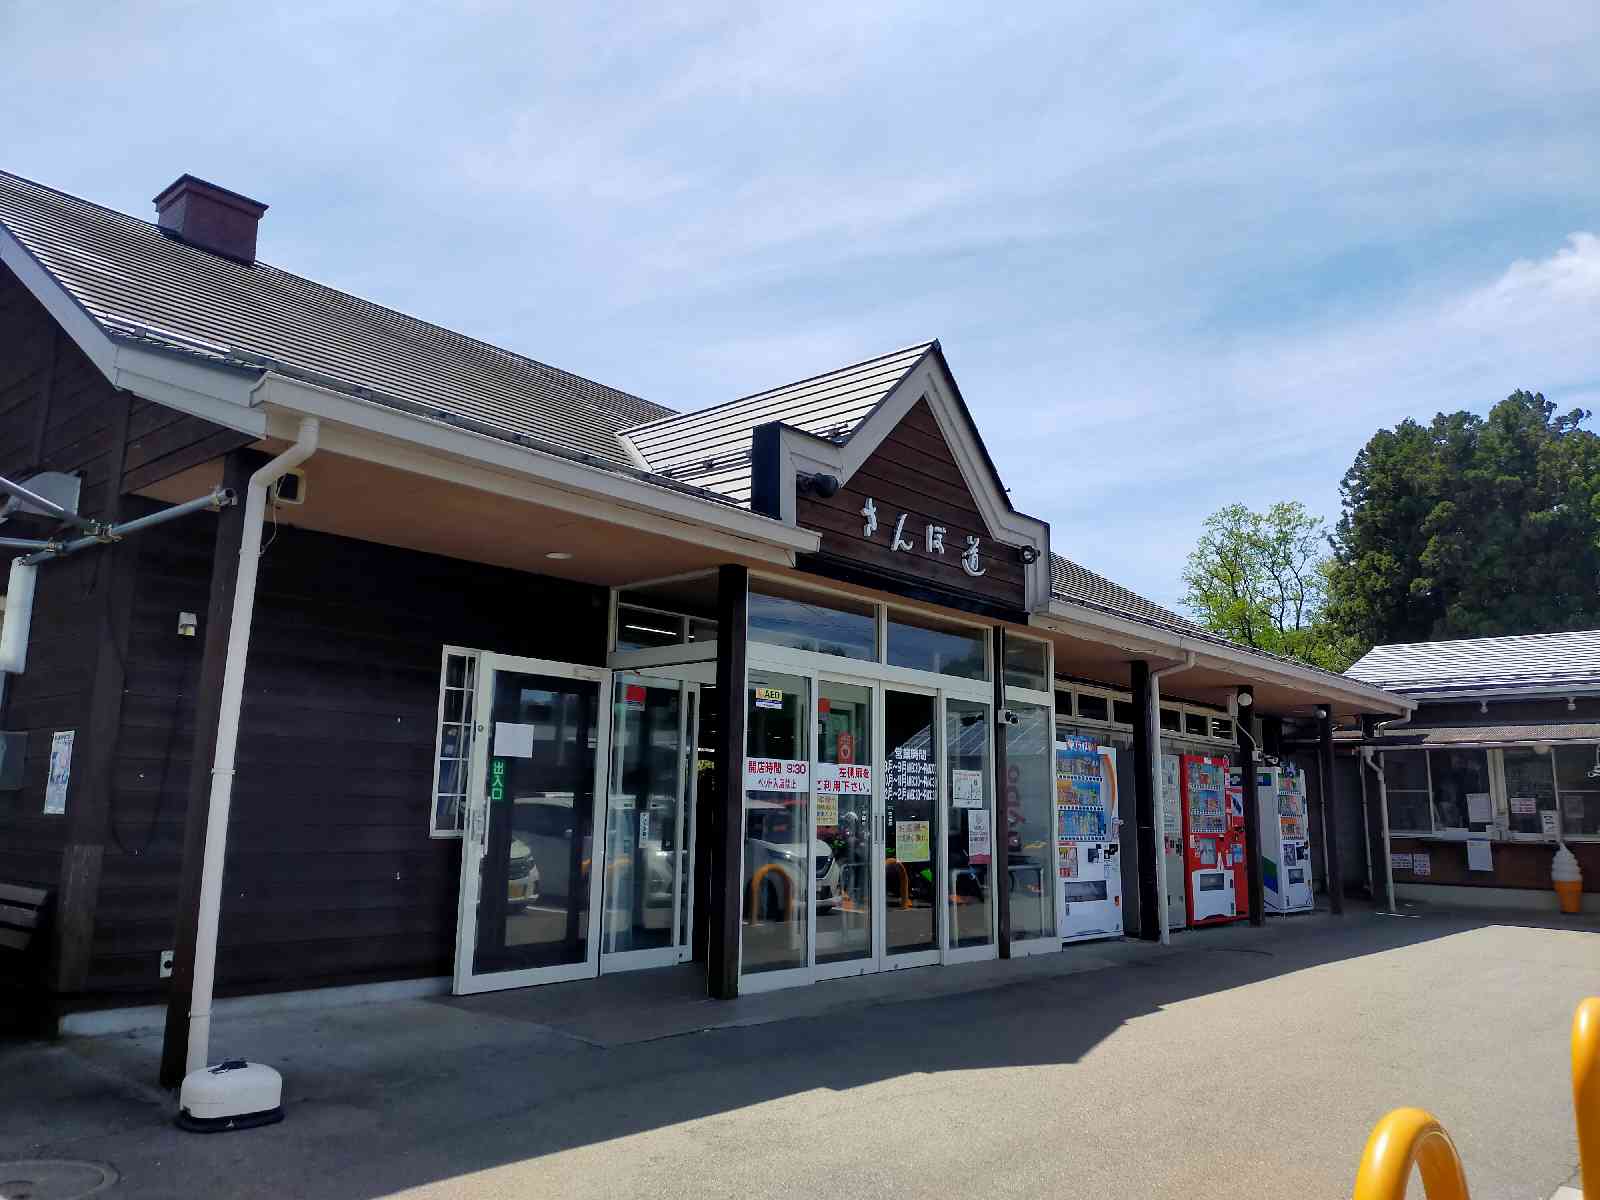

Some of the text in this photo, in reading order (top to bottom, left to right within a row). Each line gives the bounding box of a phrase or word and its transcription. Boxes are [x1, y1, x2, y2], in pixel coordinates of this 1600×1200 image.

[895, 747, 927, 761] 営業時間
[749, 761, 807, 775] 開店時間 9:30
[491, 761, 504, 800] 出入口
